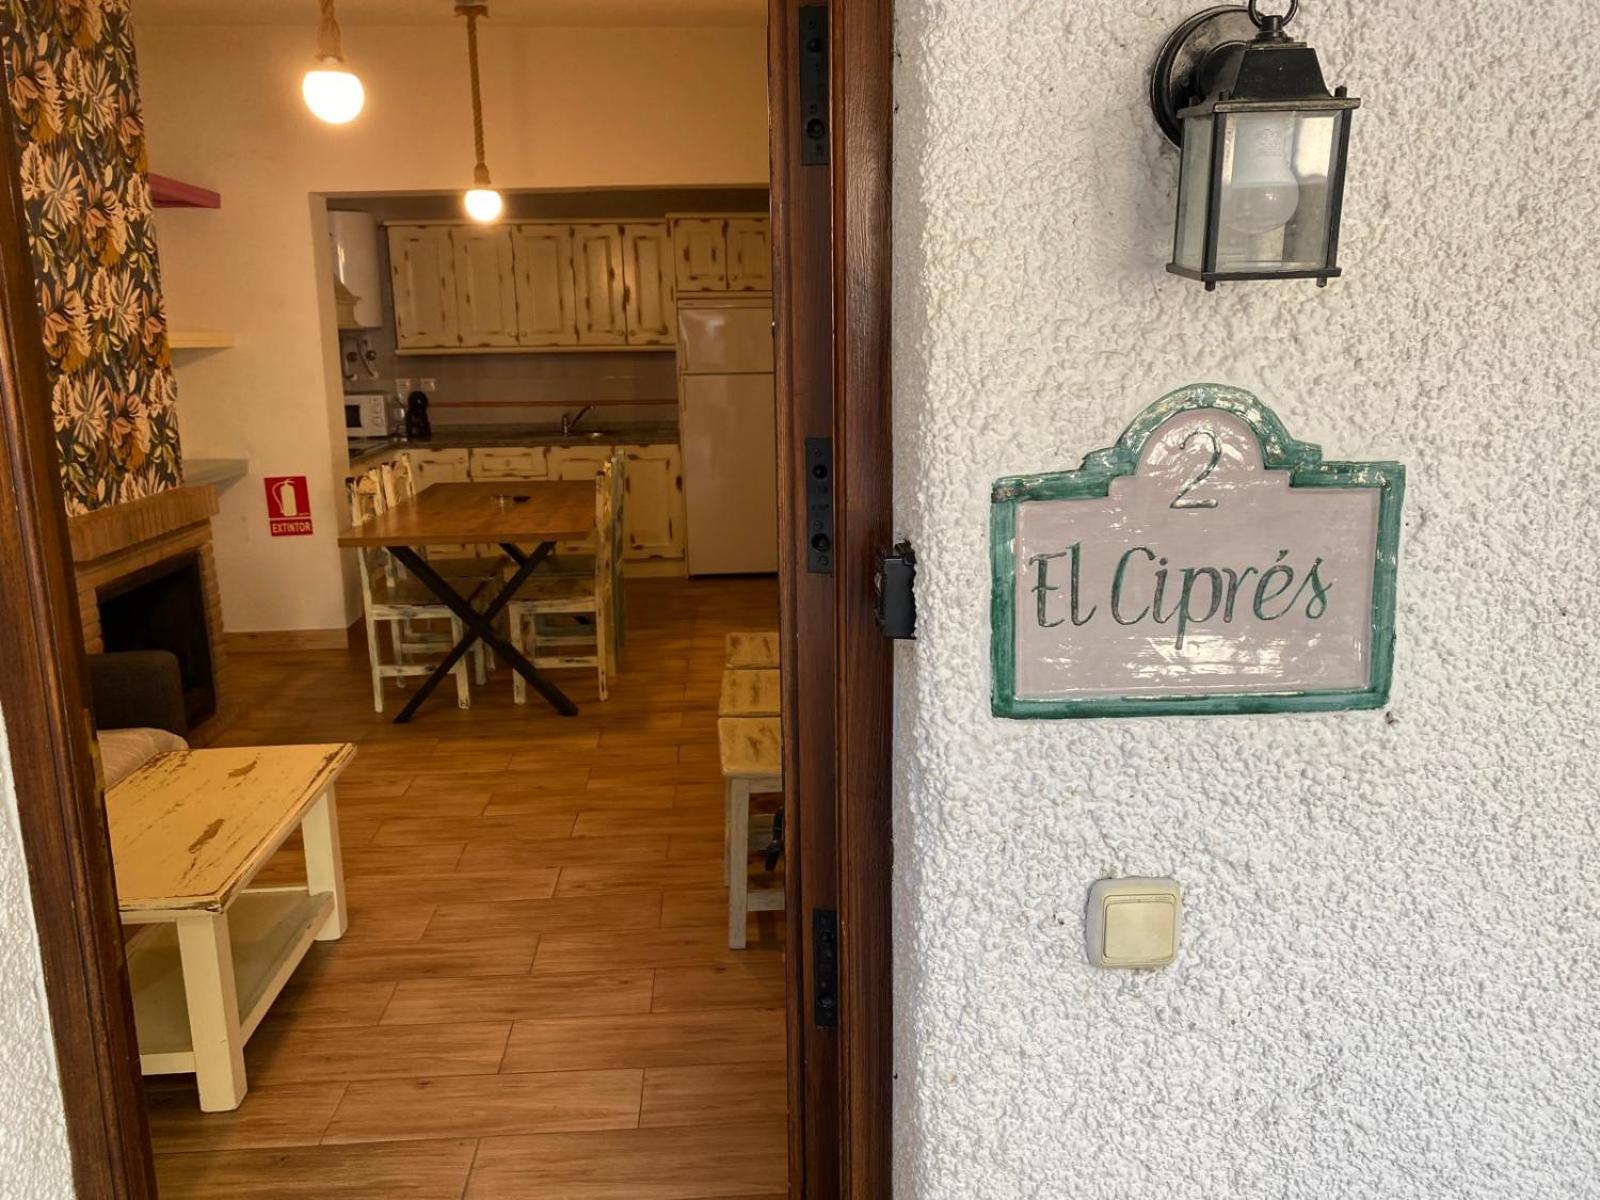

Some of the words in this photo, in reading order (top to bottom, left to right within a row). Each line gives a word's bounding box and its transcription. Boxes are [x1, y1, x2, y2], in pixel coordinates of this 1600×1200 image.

[1170, 431, 1221, 509] 2
[272, 522, 311, 533] EXTINTOR
[1029, 542, 1097, 628] El
[1111, 546, 1332, 650] Ciprés
